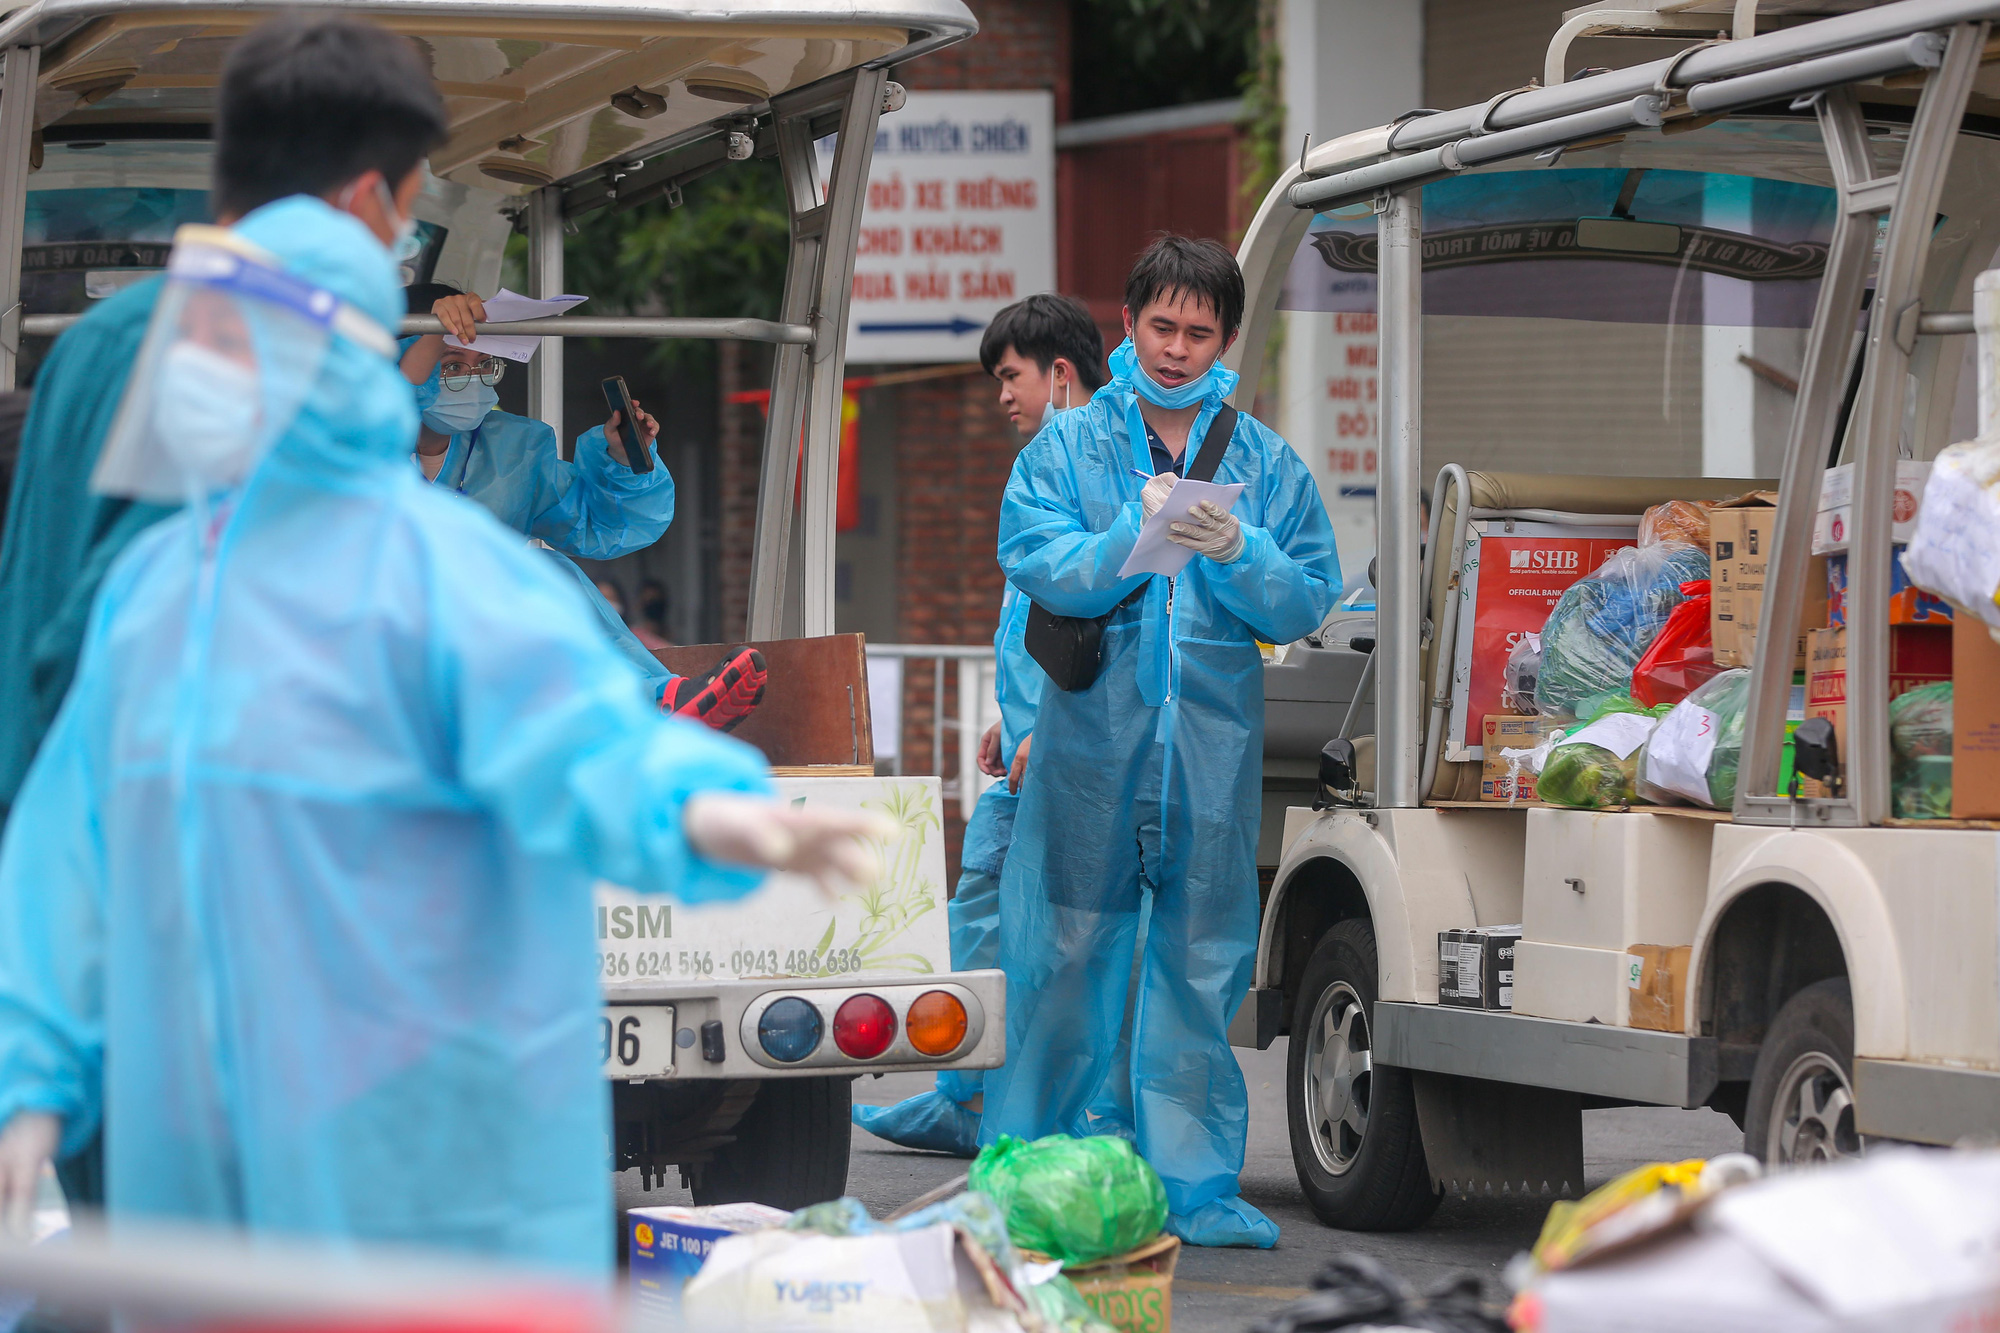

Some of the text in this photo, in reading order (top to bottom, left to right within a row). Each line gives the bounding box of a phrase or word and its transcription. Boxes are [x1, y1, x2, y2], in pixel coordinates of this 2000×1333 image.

[912, 179, 945, 211] XE
[1532, 550, 1579, 569] SHB
[1509, 588, 1562, 596] OFFICIAL BANK
[1697, 714, 1711, 737] 3
[597, 905, 672, 939] ISM
[596, 952, 630, 976] 936
[636, 951, 672, 976] 624
[731, 950, 779, 975] 0943
[785, 949, 820, 974] 486
[826, 948, 862, 973] 636
[660, 1232, 679, 1250] JET
[682, 1236, 701, 1255] 100
